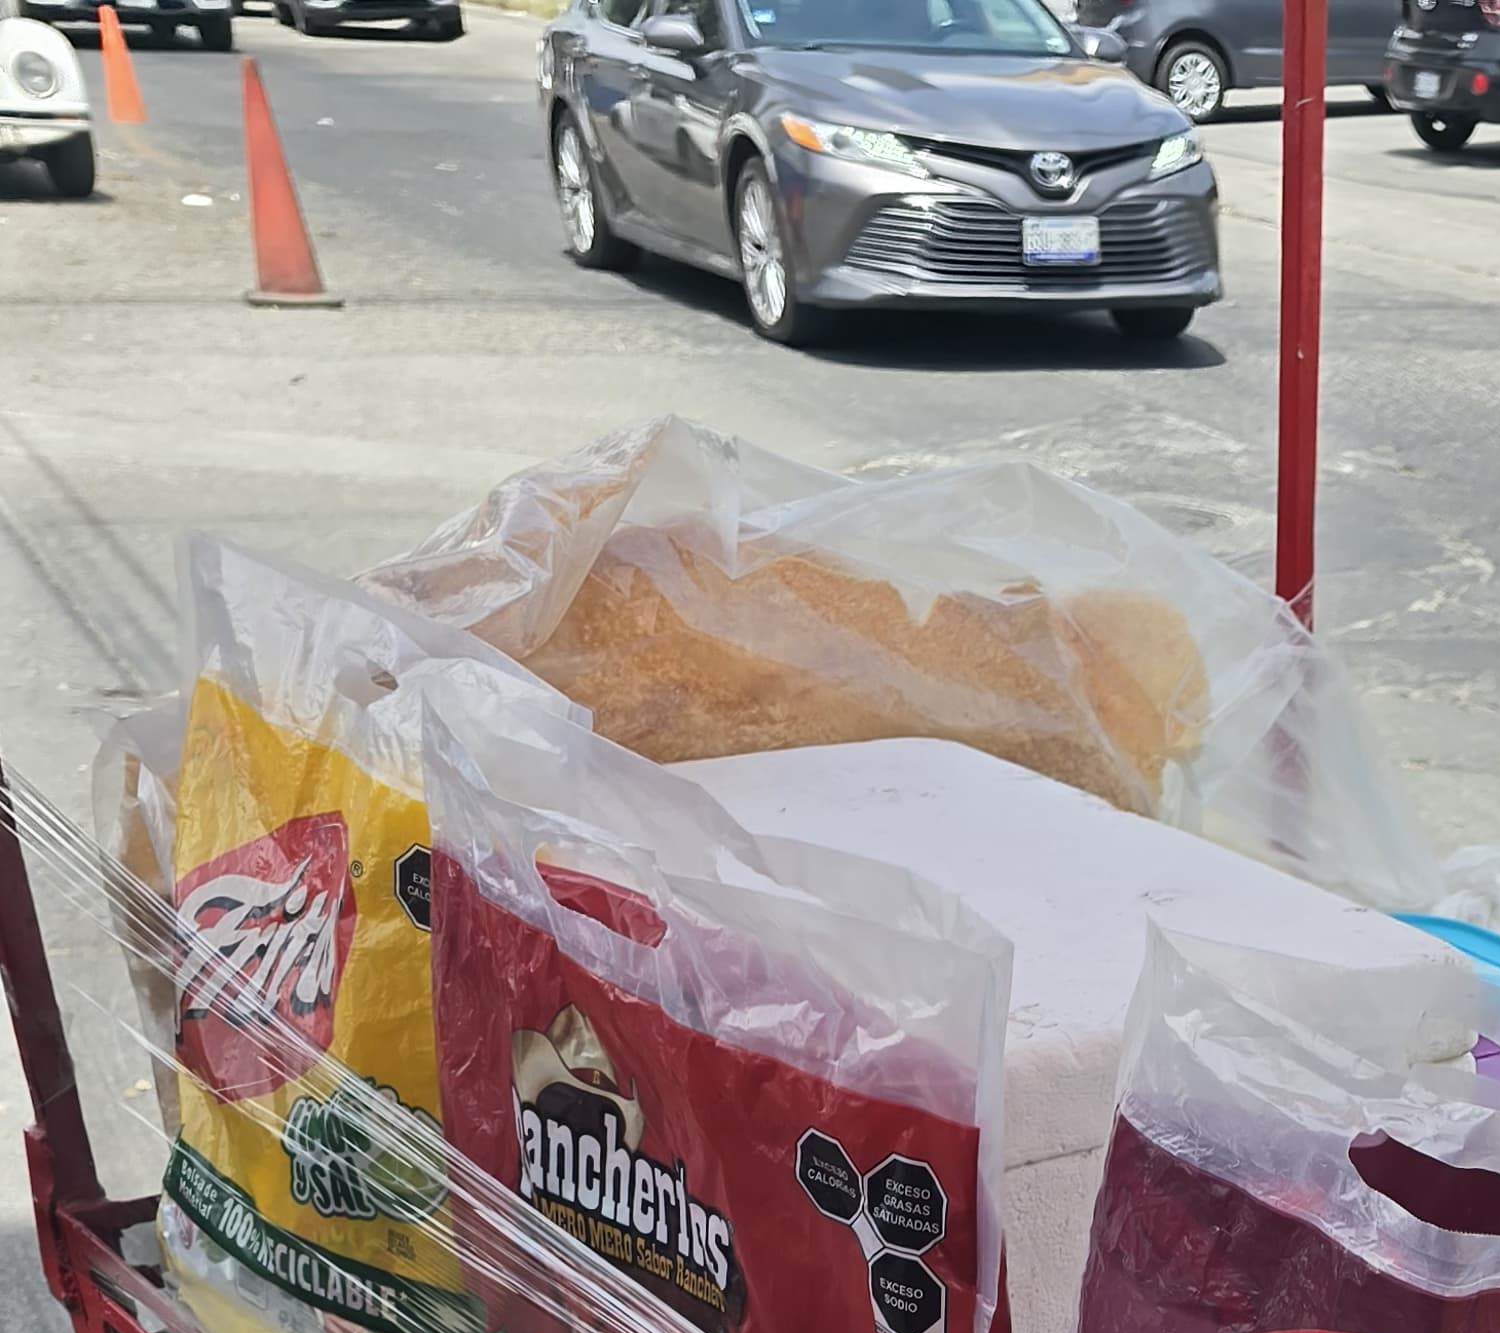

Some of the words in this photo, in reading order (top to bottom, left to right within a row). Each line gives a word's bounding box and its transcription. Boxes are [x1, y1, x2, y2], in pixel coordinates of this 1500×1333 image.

[407, 885, 431, 902] CALO
[310, 1156, 372, 1213] SAL
[886, 1178, 932, 1200] EXCESO
[883, 1194, 931, 1216] GRASAS
[872, 1206, 940, 1234] SATURADAS
[588, 1216, 633, 1264] MERO
[636, 1237, 674, 1281] Sabor
[879, 1277, 924, 1300] EXCESO
[884, 1293, 918, 1314] SODIO
